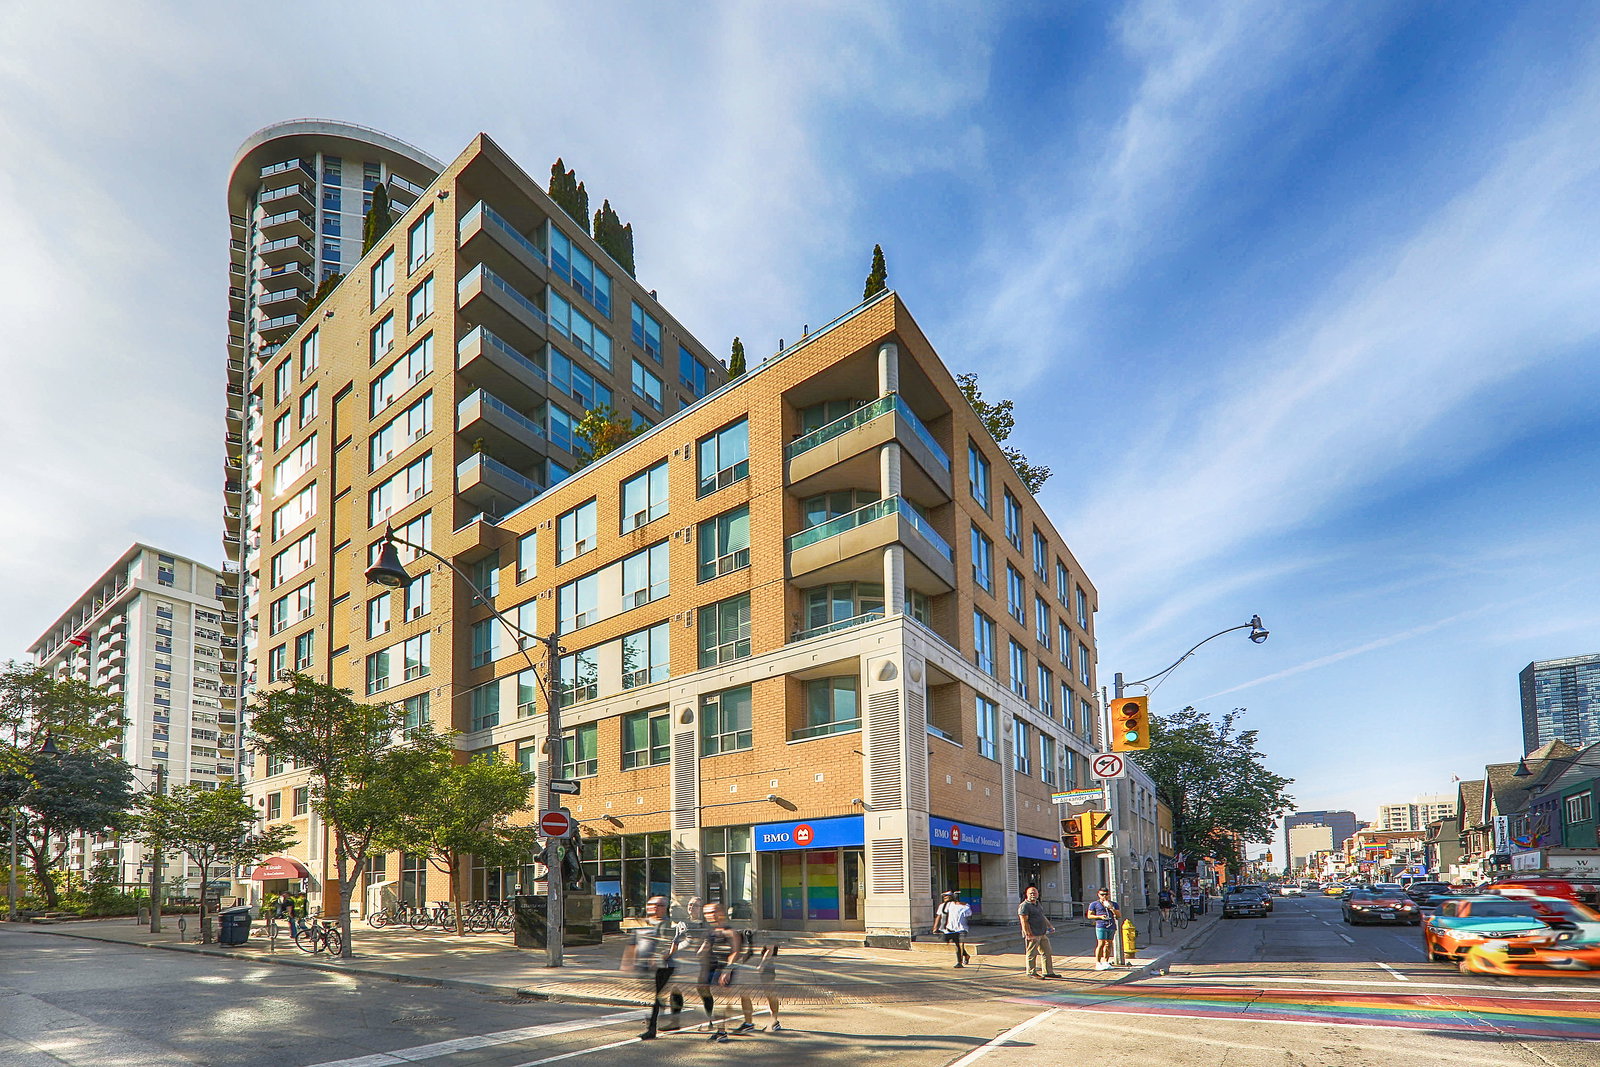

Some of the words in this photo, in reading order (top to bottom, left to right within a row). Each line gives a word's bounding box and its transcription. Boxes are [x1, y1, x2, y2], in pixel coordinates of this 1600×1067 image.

[763, 832, 790, 843] BMO
[934, 828, 949, 839] BMO
[961, 833, 975, 844] Bank
[975, 835, 981, 844] of
[981, 837, 1001, 847] Montreal
